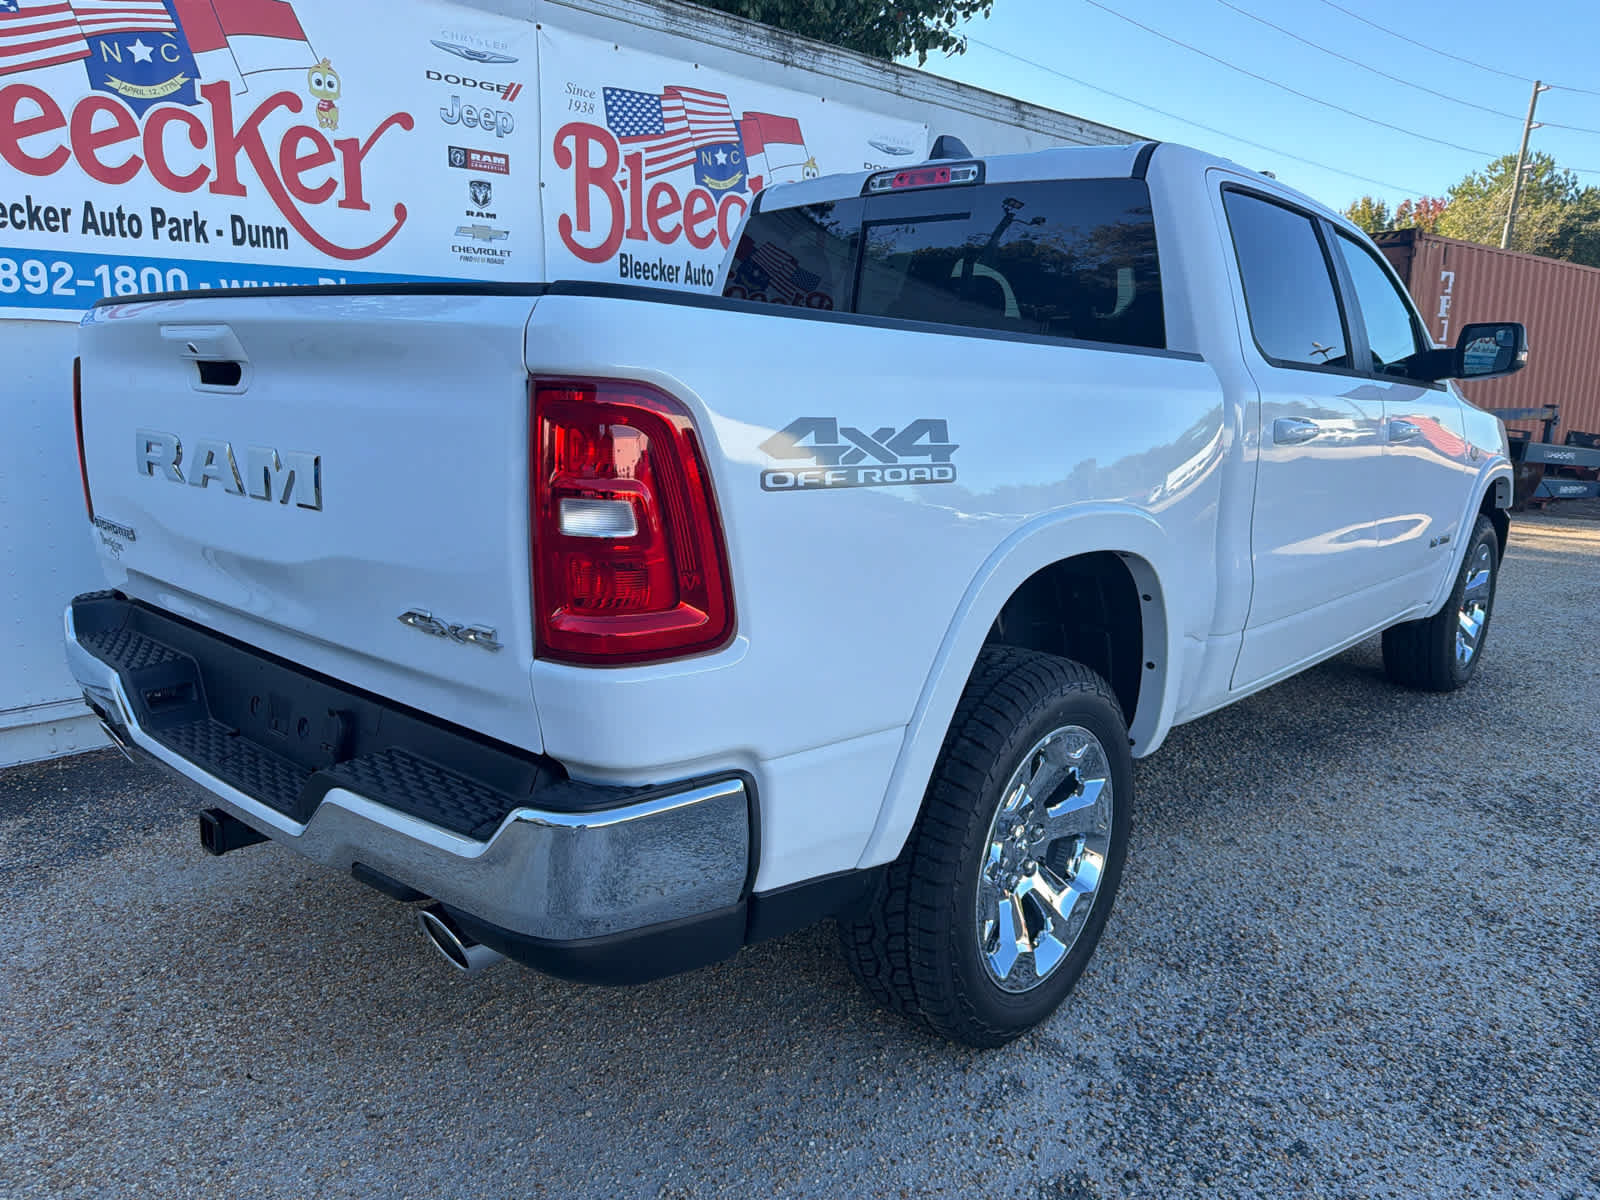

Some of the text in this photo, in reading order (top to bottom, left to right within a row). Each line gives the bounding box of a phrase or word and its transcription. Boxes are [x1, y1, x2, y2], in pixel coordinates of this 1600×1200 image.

[100, 41, 181, 64] N C
[425, 70, 510, 94] DODGE
[564, 81, 597, 99] Since
[440, 95, 515, 137] Jeep
[568, 98, 595, 114] 1938
[471, 153, 505, 165] RAM
[701, 150, 741, 166] N C
[553, 121, 764, 264] Bleec
[81, 201, 143, 240] Auto
[151, 207, 209, 244] Park
[231, 214, 289, 250] Dunn
[465, 210, 497, 219] RAM
[451, 245, 512, 257] CHEVROLET
[0, 257, 188, 298] 892-1800
[619, 253, 680, 284] Bleecker
[684, 260, 714, 287] Auto
[135, 427, 324, 512] RAM
[764, 466, 953, 488] OFF ROAD
